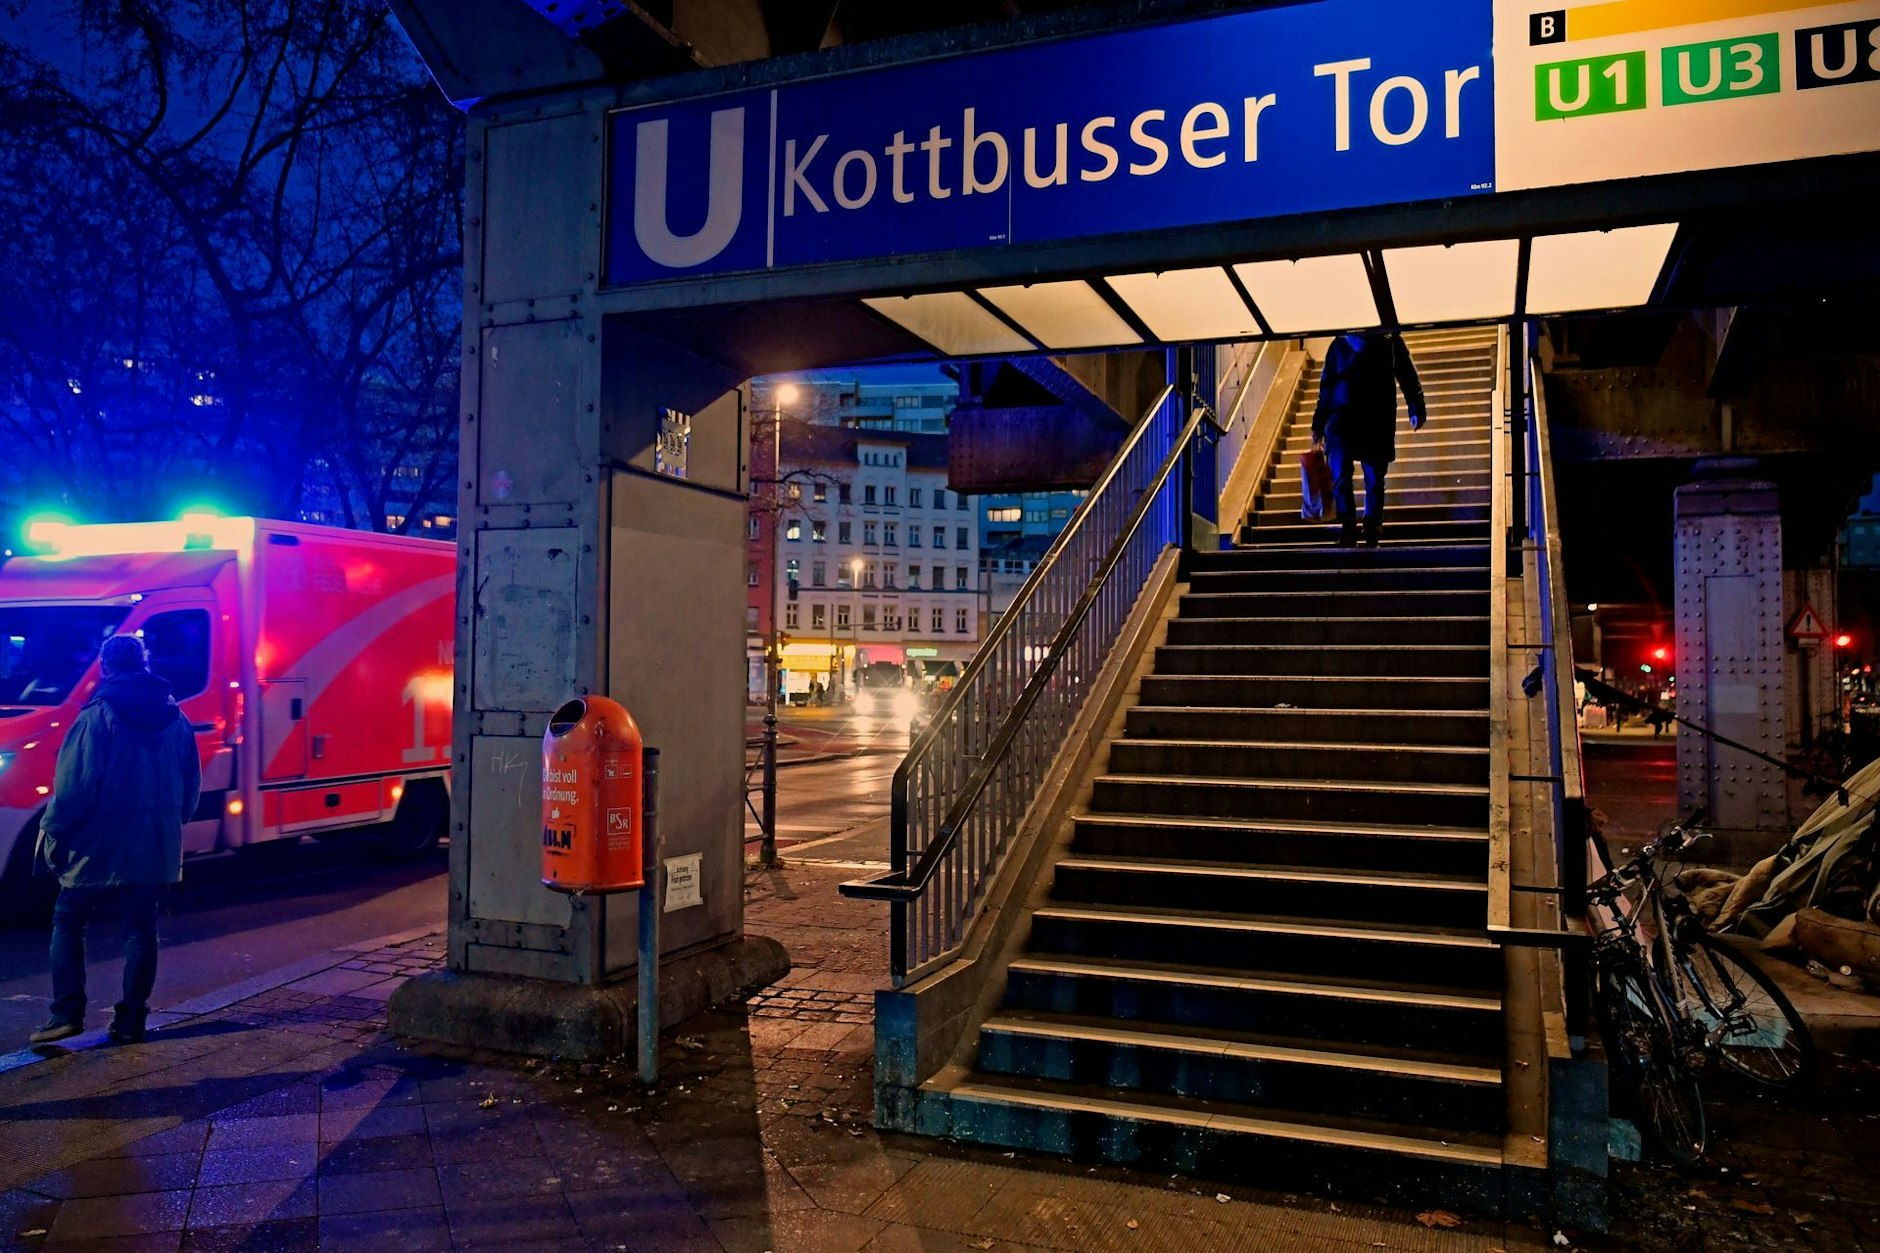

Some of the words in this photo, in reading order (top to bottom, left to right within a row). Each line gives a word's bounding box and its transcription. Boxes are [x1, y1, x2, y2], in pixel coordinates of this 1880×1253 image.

[1541, 16, 1555, 38] B
[1549, 59, 1627, 111] U1
[1678, 42, 1764, 95] U3
[634, 106, 746, 268] U
[784, 94, 1277, 216] Kottbusser
[1314, 57, 1480, 152] Tor
[562, 768, 577, 783] voll
[610, 812, 629, 830] BSR
